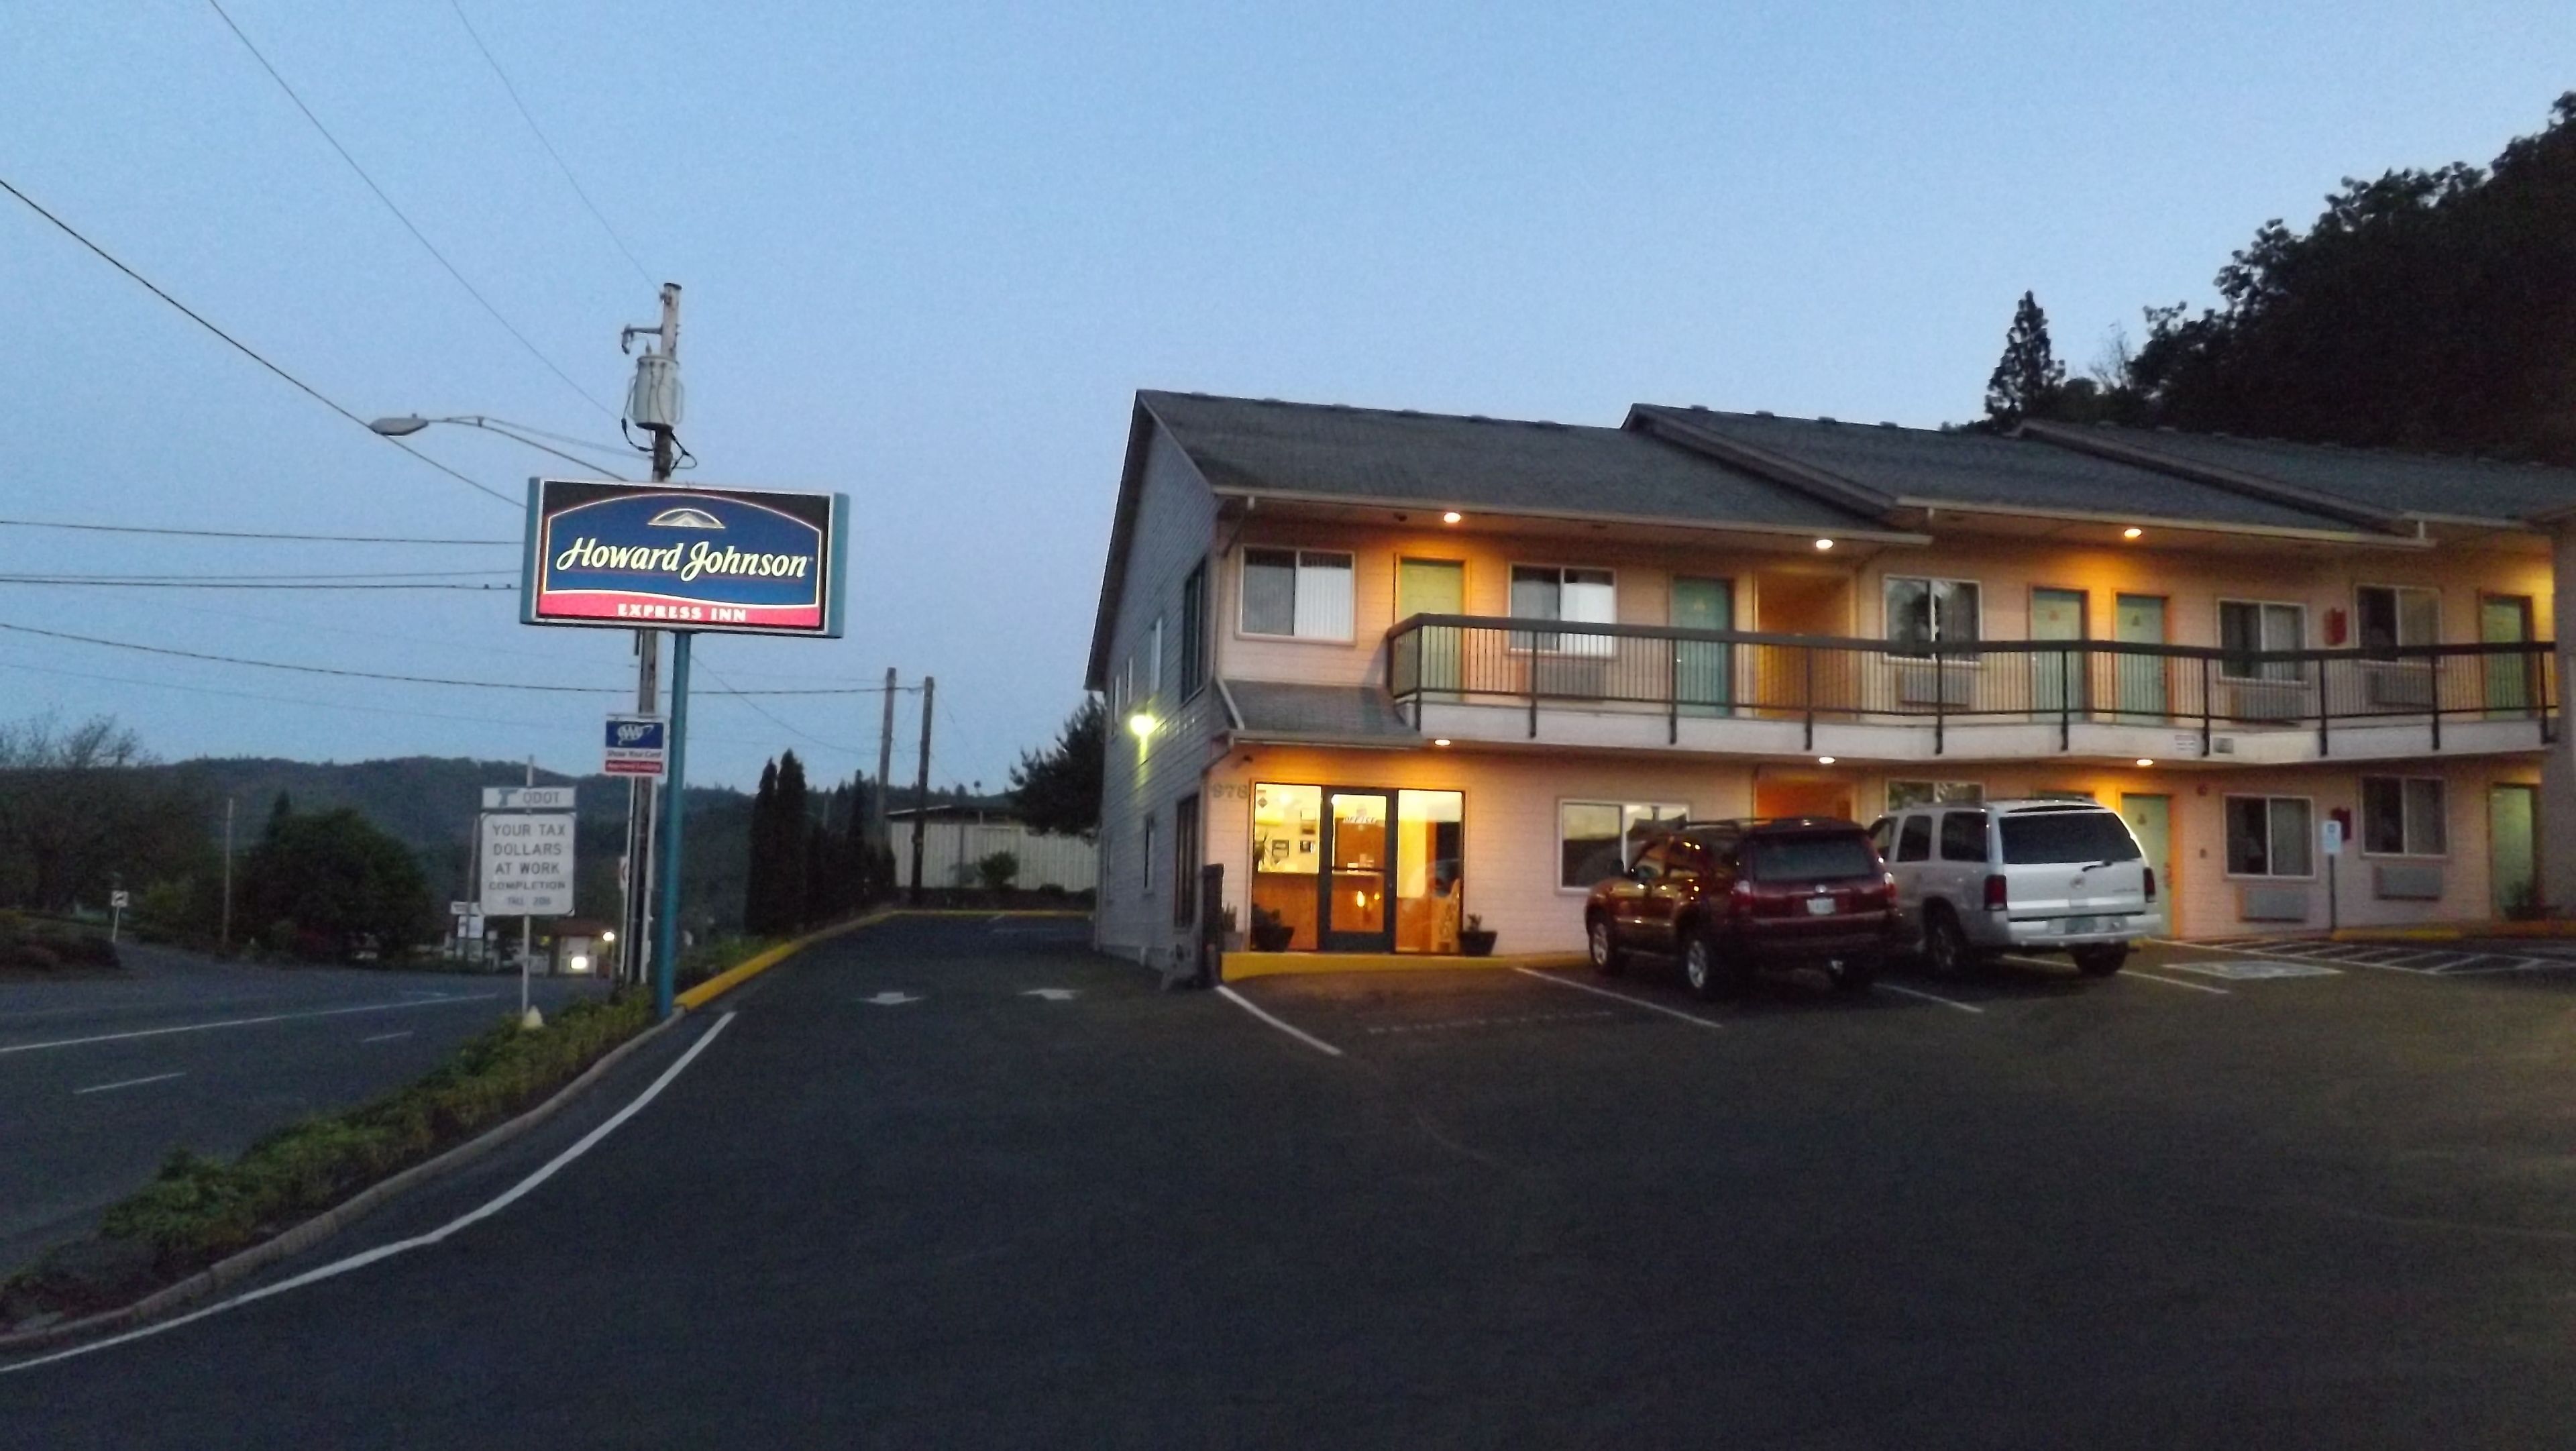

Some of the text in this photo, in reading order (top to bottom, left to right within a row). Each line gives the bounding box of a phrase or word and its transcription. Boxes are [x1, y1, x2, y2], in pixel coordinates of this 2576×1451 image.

[556, 537, 808, 582] Howard Johnson
[618, 603, 747, 623] EXPRESS INN
[523, 792, 561, 804] ODOT
[492, 824, 566, 836] YOUR TAX
[493, 843, 561, 855] DOLLARS
[495, 862, 560, 874] AT WORK
[488, 881, 566, 890] COMPLETION
